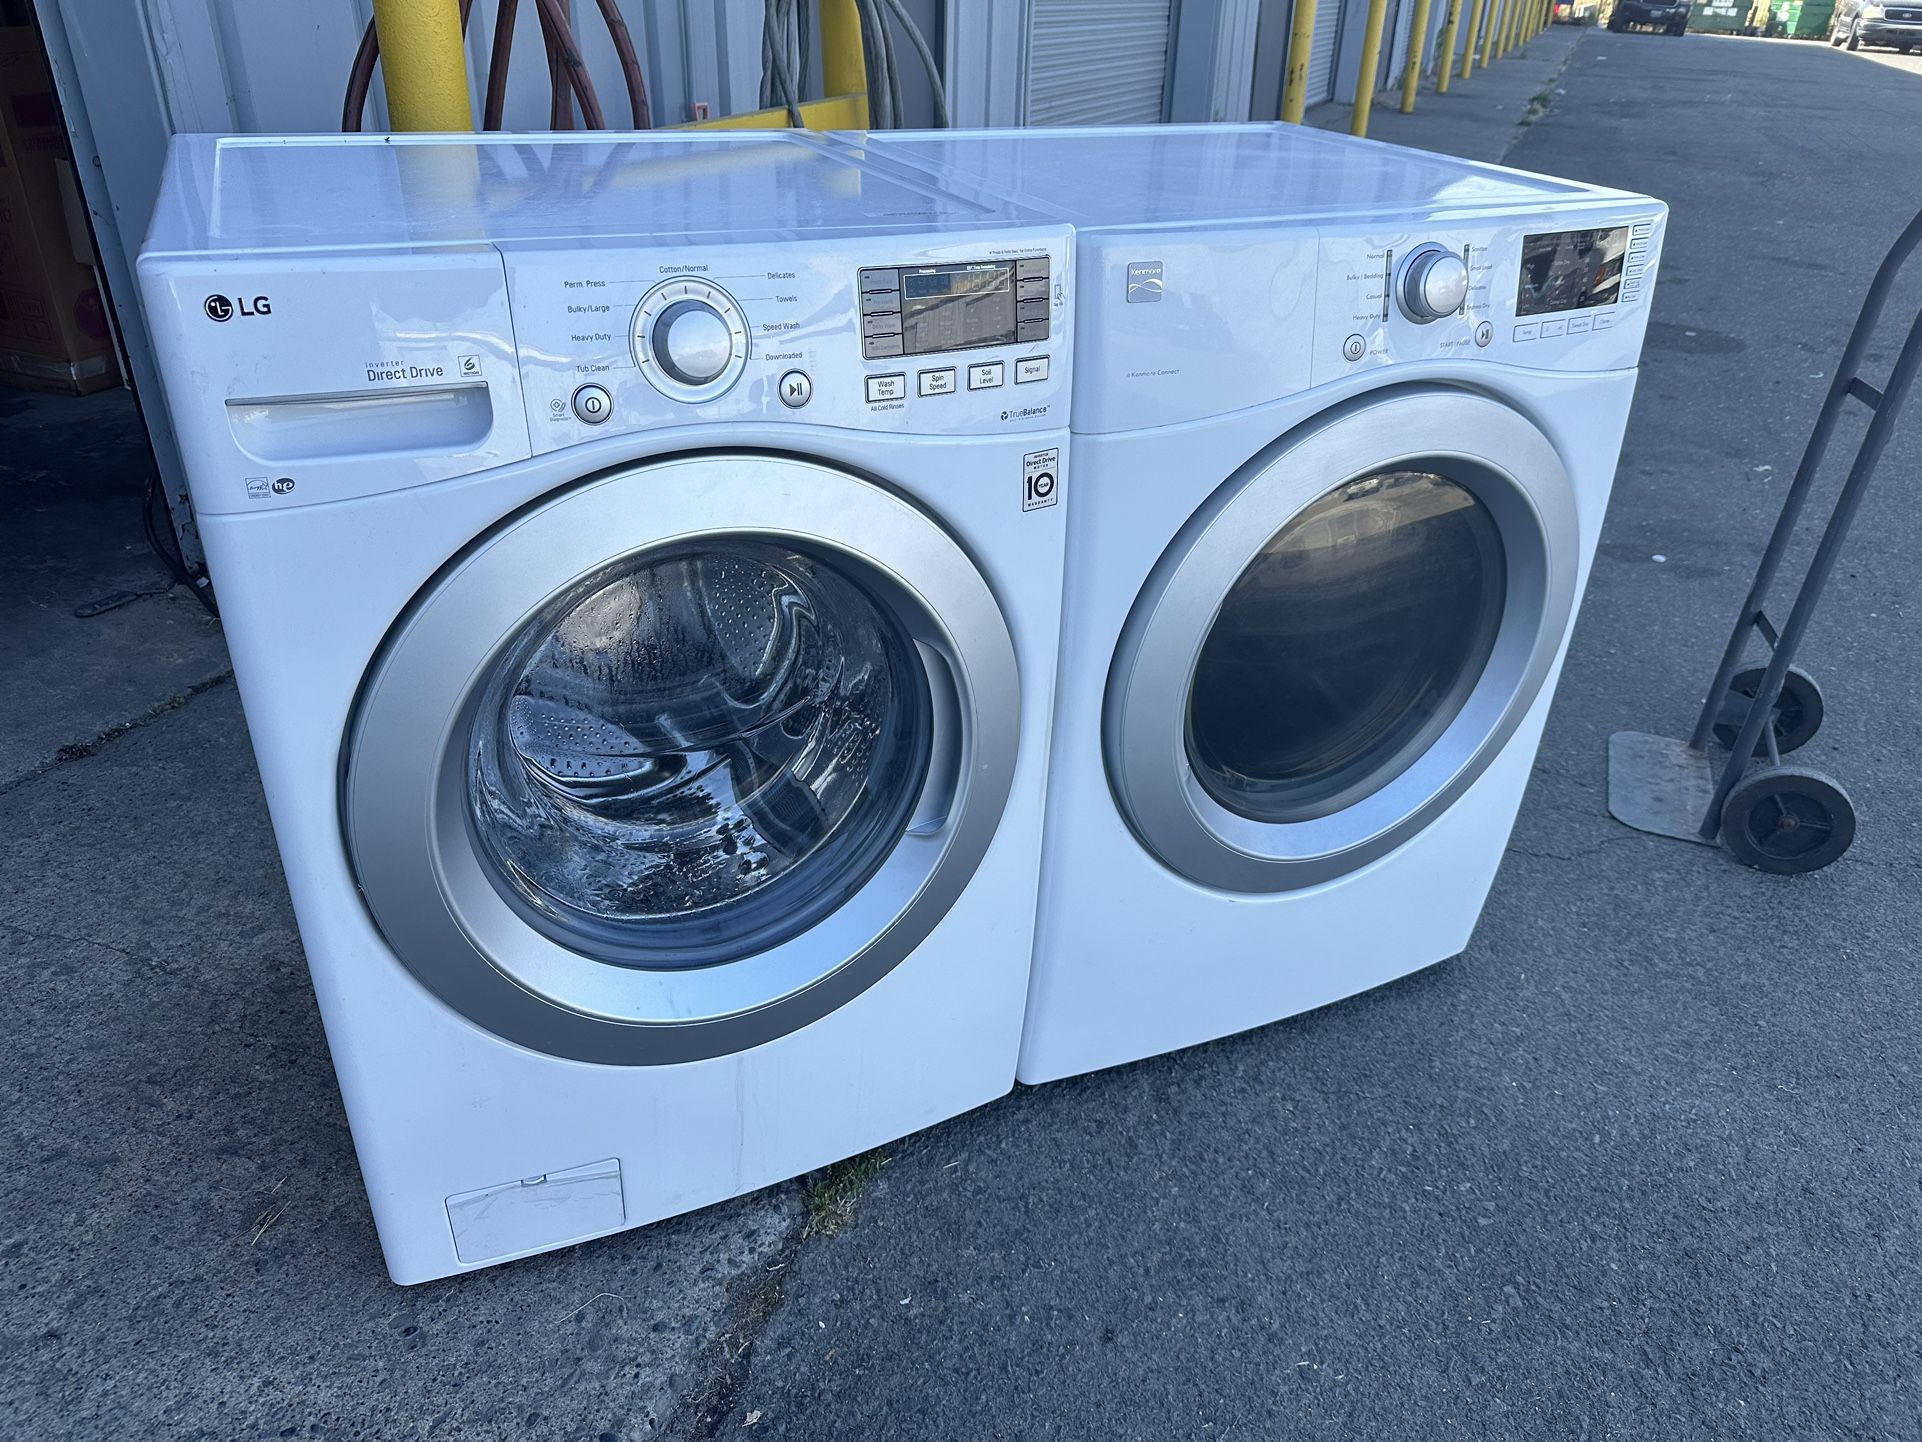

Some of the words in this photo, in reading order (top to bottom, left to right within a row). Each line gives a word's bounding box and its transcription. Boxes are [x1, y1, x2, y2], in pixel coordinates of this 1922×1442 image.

[659, 264, 708, 274] Cotton/Normal
[1131, 267, 1161, 276] Kenmore
[767, 271, 796, 280] Delicates
[564, 280, 584, 289] Perm.
[586, 279, 606, 288] Press
[775, 294, 798, 303] Towels
[238, 296, 272, 317] LG
[567, 303, 610, 314] Bulky/Large
[762, 323, 782, 332] Speed
[783, 321, 800, 330] Wash
[571, 334, 592, 343] Heavy
[594, 333, 611, 342] Duty
[765, 351, 803, 361] Downloaded
[365, 360, 404, 369] Inverter
[575, 364, 590, 373] Tub
[590, 363, 610, 373] Clean
[366, 368, 408, 382] Direct
[409, 366, 444, 379] Drive
[981, 368, 992, 376] Soil
[1024, 365, 1041, 375] Signal
[877, 379, 895, 388] Wash
[931, 374, 945, 383] Spin
[979, 376, 994, 385] Level
[929, 382, 947, 391] Speed
[878, 387, 894, 397] Temp
[1026, 458, 1041, 467] Direct
[1042, 456, 1056, 464] Drive
[1026, 471, 1055, 501] 10
